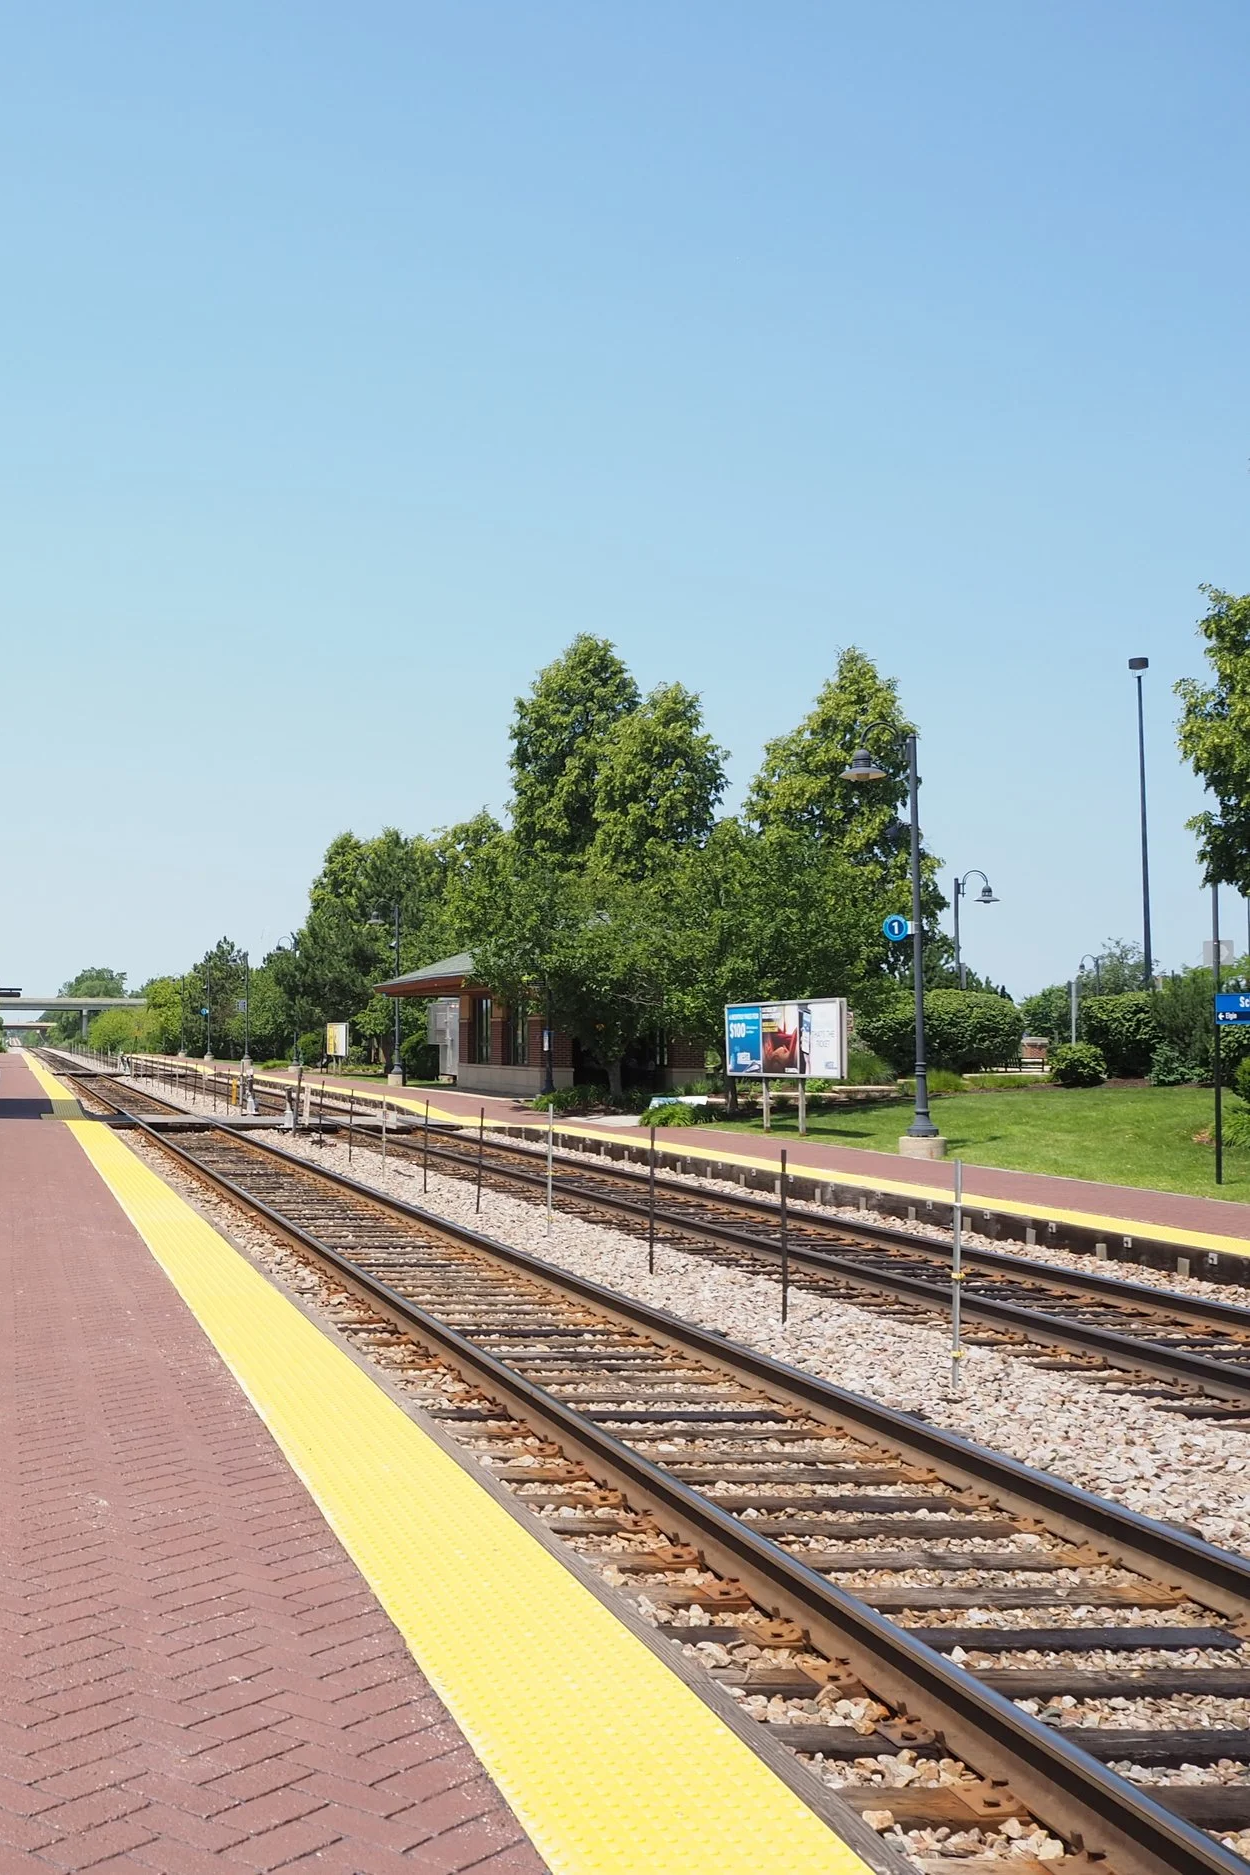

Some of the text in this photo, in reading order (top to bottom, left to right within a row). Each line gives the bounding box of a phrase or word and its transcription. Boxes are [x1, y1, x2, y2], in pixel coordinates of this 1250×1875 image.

[891, 921, 899, 935] 1
[1225, 1012, 1238, 1021] Elgin
[730, 1022, 745, 1039] $100
